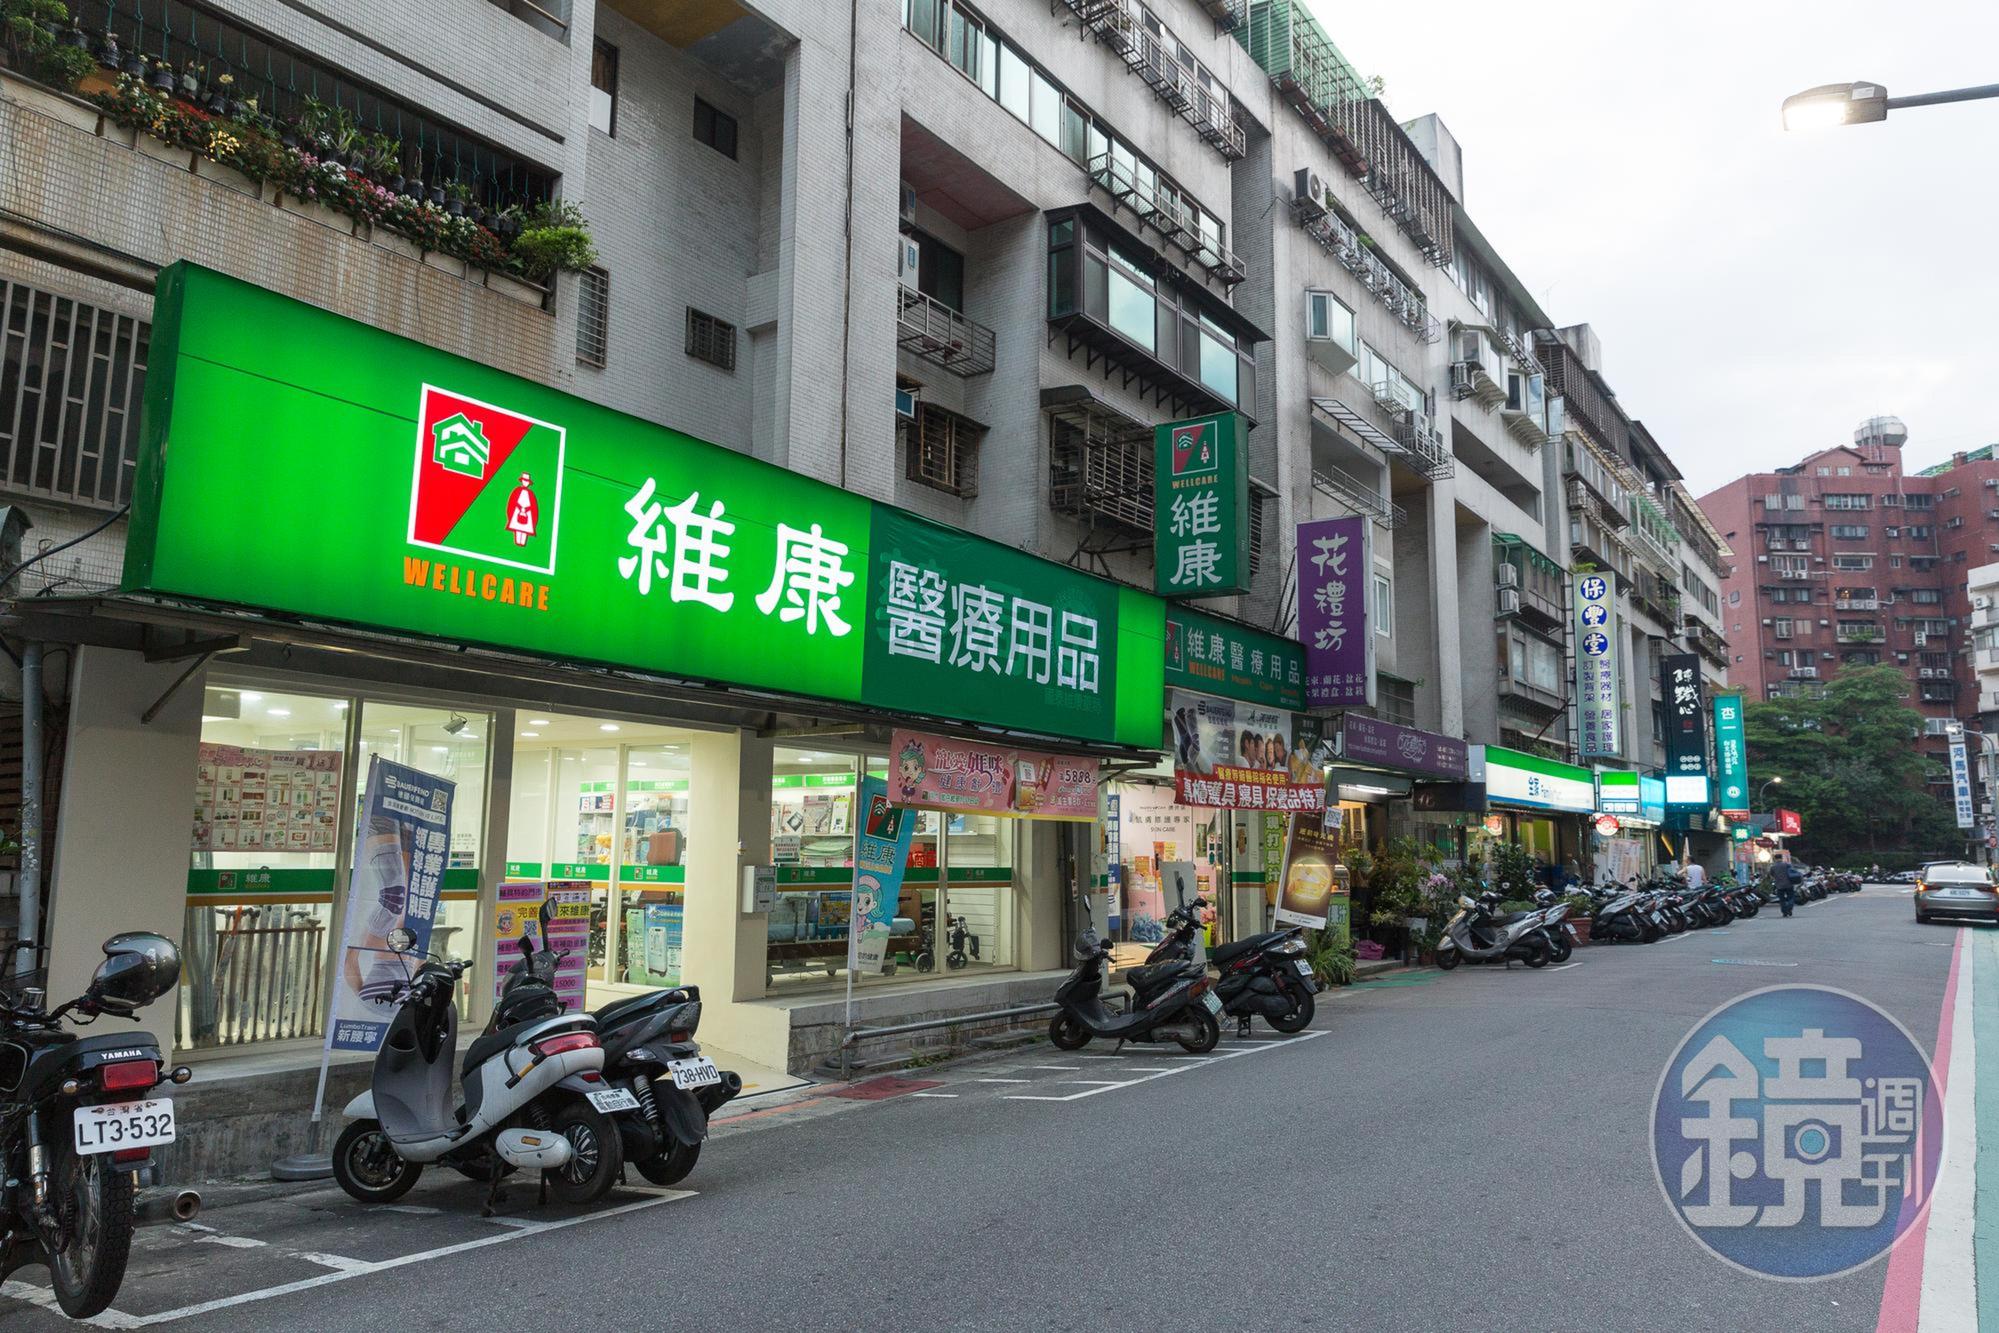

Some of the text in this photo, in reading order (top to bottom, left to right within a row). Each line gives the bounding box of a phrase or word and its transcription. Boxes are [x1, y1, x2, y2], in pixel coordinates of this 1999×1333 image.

[1172, 474, 1218, 489] WELLCARE
[617, 477, 855, 637] 維康
[1170, 490, 1222, 586] 維康
[403, 556, 550, 611] WELLCARE
[1310, 532, 1349, 651] 花禮坊
[886, 560, 1099, 694] 醫療用品
[1187, 627, 1300, 685] 維康醫療用品
[1188, 661, 1225, 682] WELLCARE
[1601, 709, 1614, 753] 居家護理
[859, 840, 897, 866] 維康
[101, 1049, 142, 1060] YAMAHA
